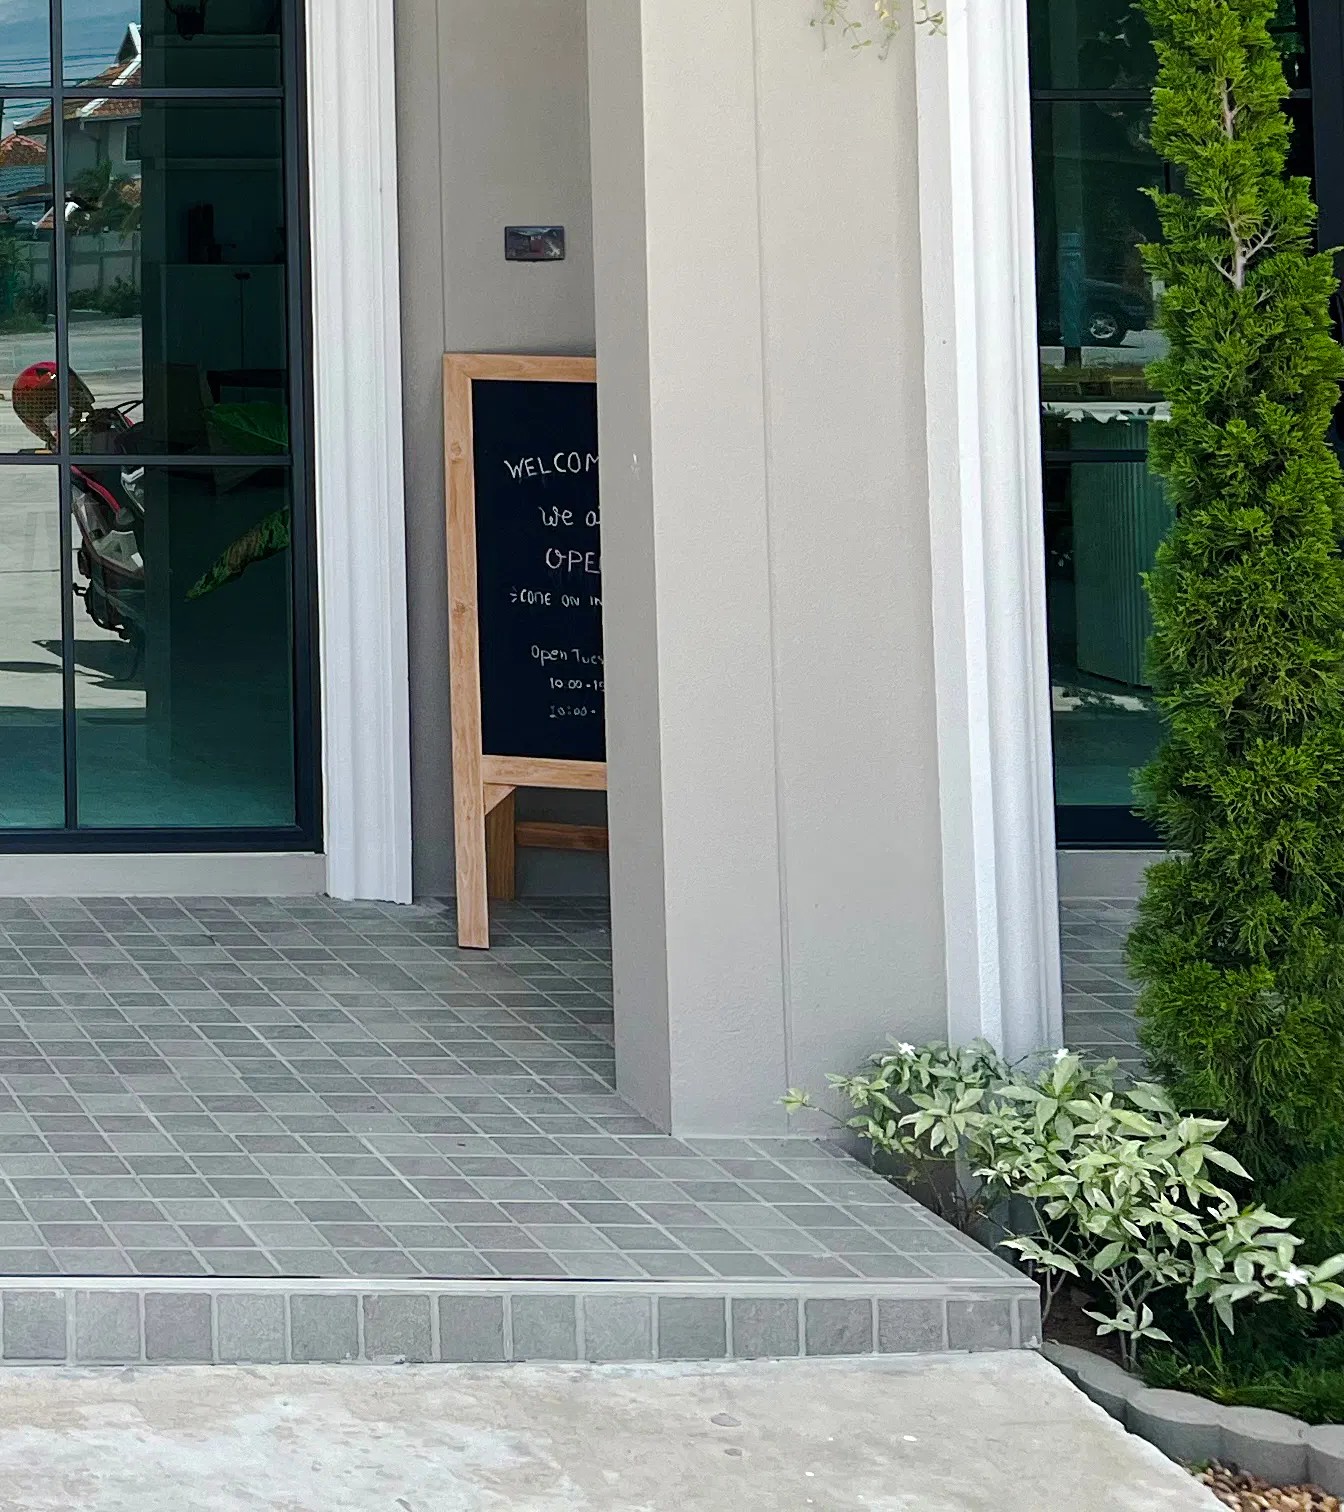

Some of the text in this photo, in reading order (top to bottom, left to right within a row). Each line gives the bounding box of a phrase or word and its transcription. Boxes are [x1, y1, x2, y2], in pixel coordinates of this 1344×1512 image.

[537, 505, 574, 527] We
[545, 548, 601, 574] OPE
[561, 594, 580, 608] ON
[531, 644, 568, 667] Open
